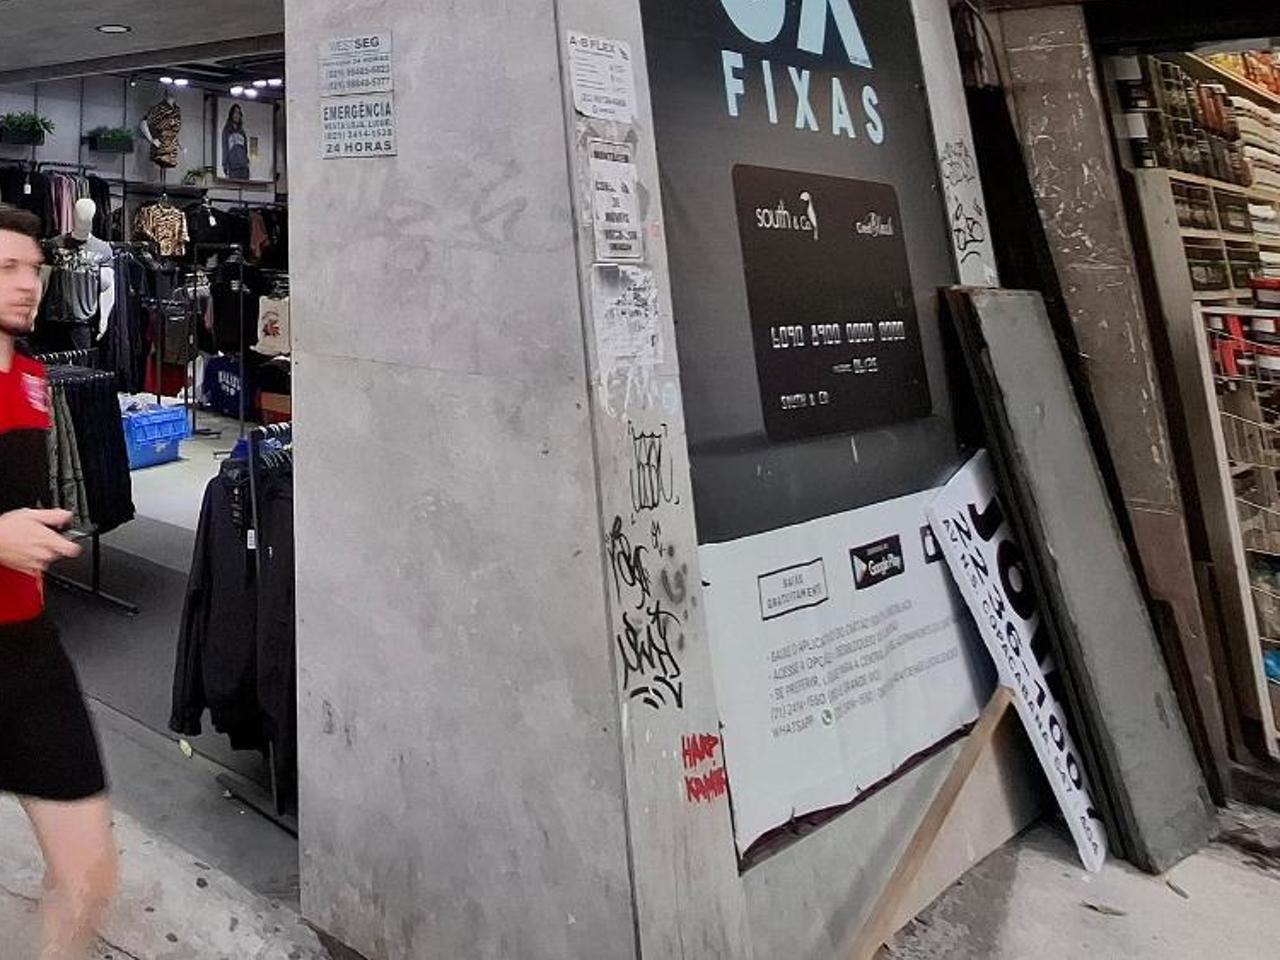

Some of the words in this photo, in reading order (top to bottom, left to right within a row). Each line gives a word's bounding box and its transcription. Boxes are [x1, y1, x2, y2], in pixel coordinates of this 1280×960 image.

[721, 49, 885, 145] FIXAS
[323, 101, 391, 121] EMERGÊNCIA
[326, 143, 340, 153] 24
[344, 140, 392, 152] HORAS
[755, 199, 791, 229] south
